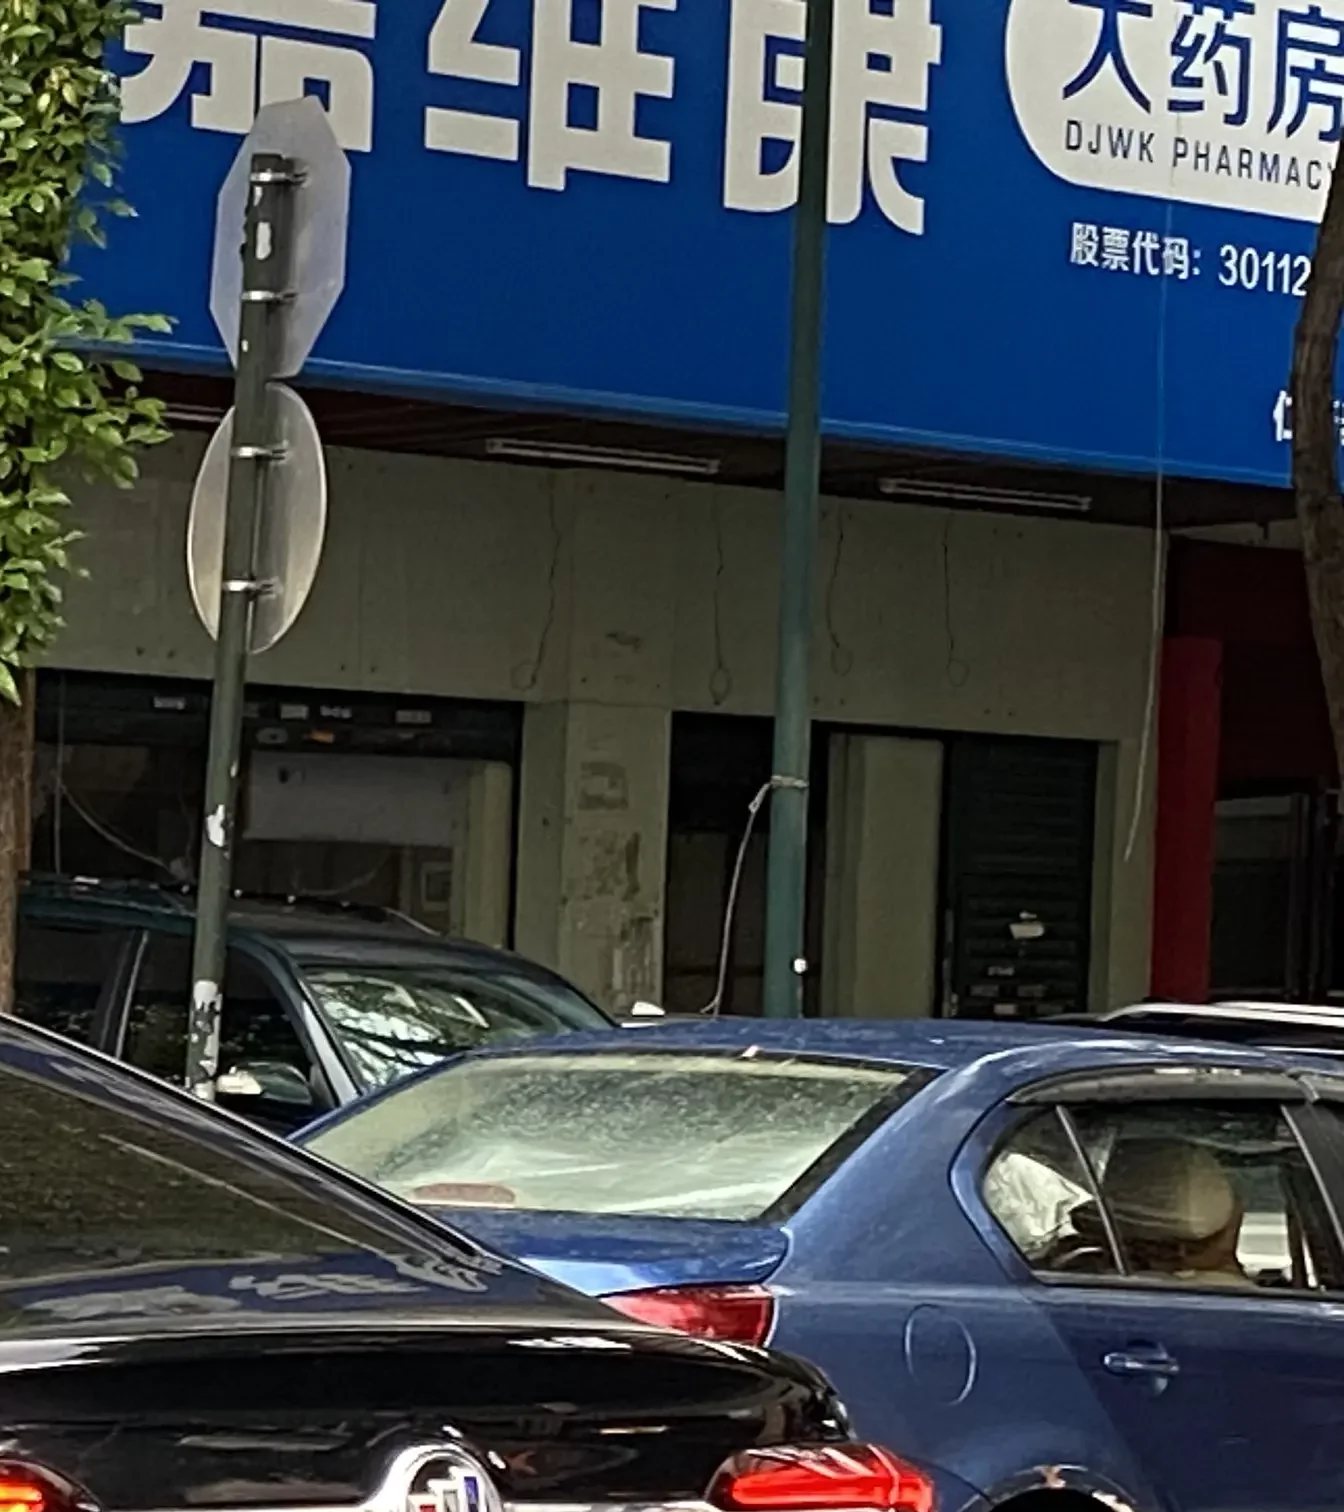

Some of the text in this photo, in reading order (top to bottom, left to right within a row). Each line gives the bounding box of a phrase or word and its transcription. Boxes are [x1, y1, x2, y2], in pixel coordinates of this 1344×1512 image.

[1063, 0, 1344, 143] 大药房
[1065, 119, 1333, 191] DJWK PHARMAC
[1069, 220, 1203, 281] 股票代码：
